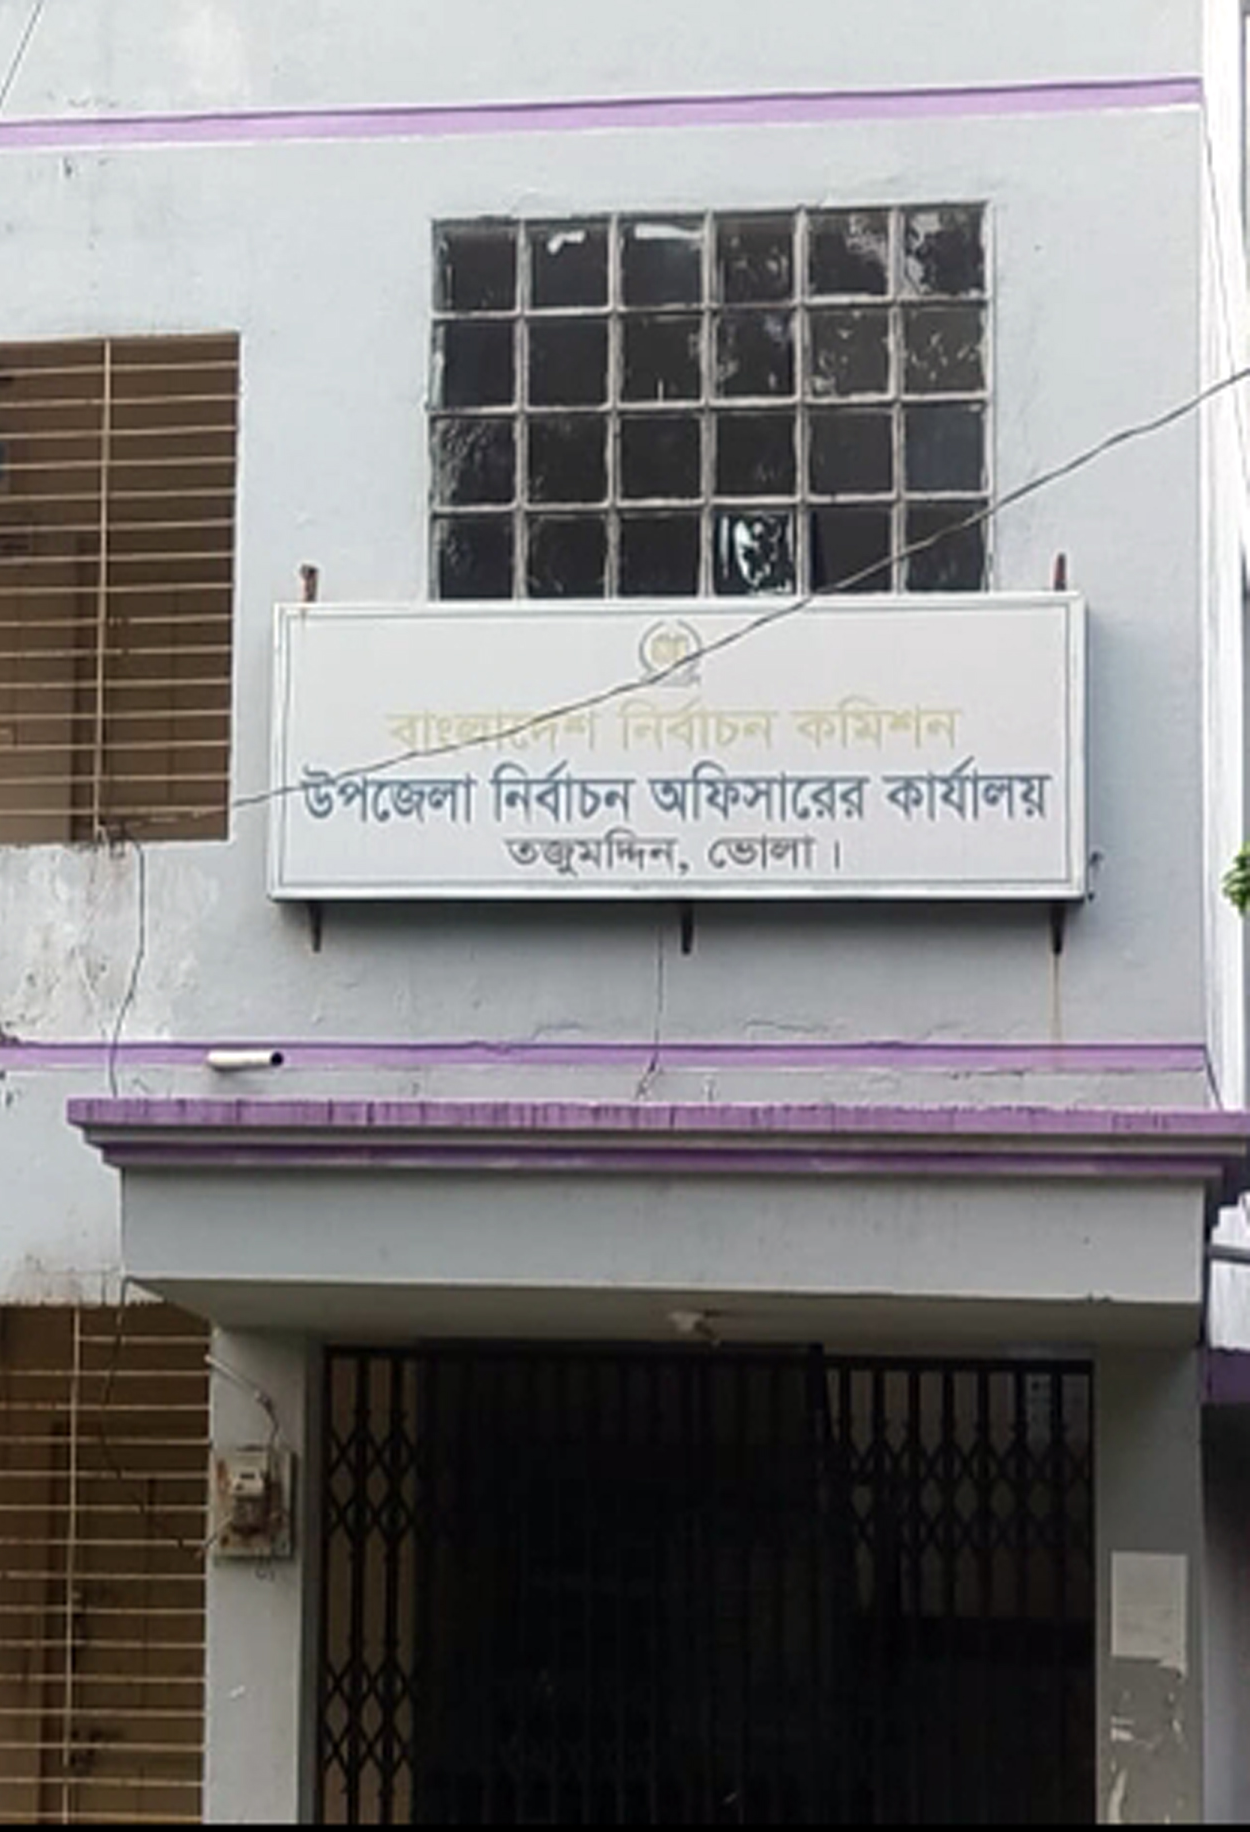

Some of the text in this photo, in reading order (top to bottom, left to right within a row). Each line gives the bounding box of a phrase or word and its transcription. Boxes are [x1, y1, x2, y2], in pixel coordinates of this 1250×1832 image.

[387, 696, 962, 751] বাংলাদেশ নির্বাচন কমিশন
[300, 755, 1053, 823] উপজেলা নির্বাচন অফিসারের কার্যালয়
[503, 827, 690, 877] তজুমদ্দিন,
[707, 832, 815, 870] ভোলা
